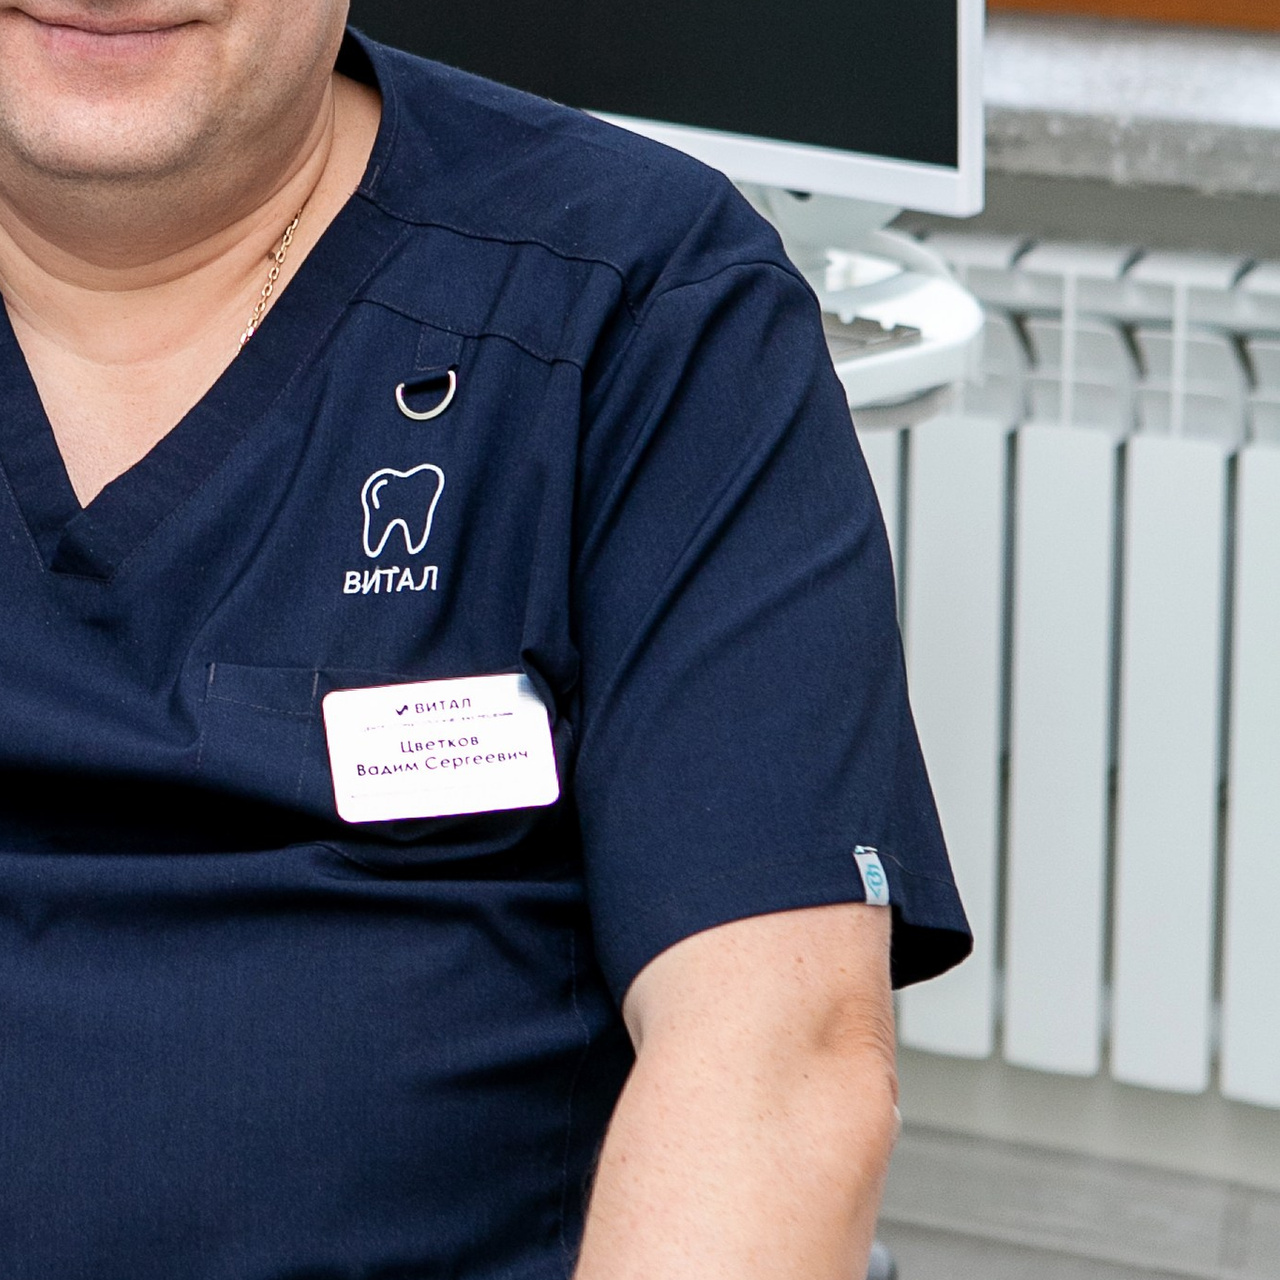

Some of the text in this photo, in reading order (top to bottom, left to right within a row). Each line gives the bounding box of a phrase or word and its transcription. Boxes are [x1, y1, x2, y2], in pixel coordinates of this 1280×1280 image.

[343, 565, 438, 595] ВИТАЛ
[414, 697, 472, 714] ВИТАЛ
[400, 736, 480, 754] Цветков
[356, 750, 528, 777] Вадим Сергеевич
